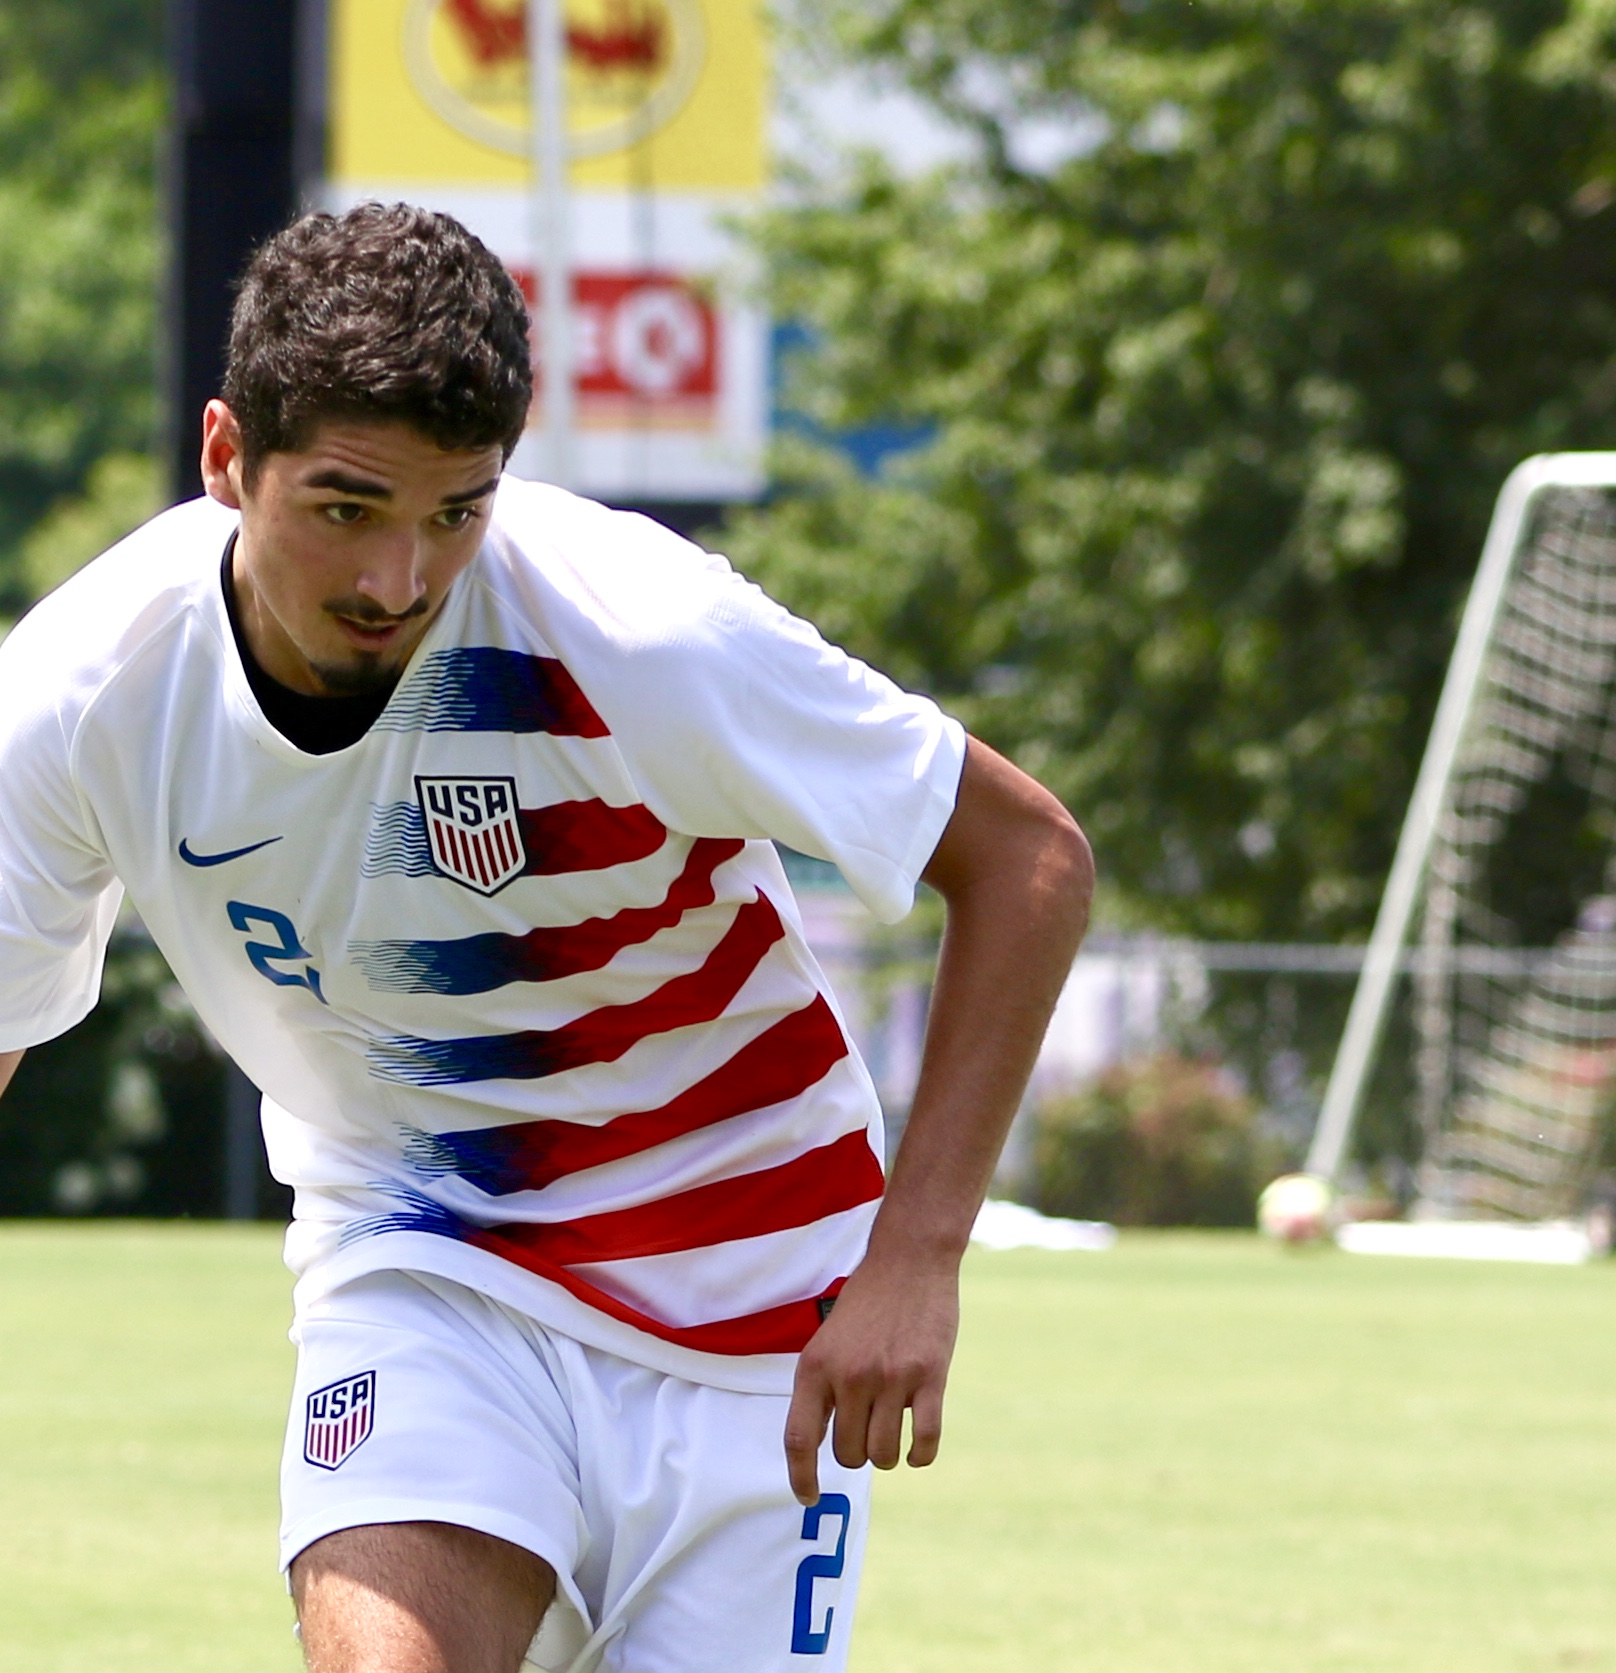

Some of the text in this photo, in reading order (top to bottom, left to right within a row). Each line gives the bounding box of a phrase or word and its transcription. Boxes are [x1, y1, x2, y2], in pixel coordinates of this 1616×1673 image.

[426, 785, 508, 827] USA
[225, 900, 328, 1005] 2
[312, 1377, 369, 1419] USA
[790, 1492, 851, 1655] 2
